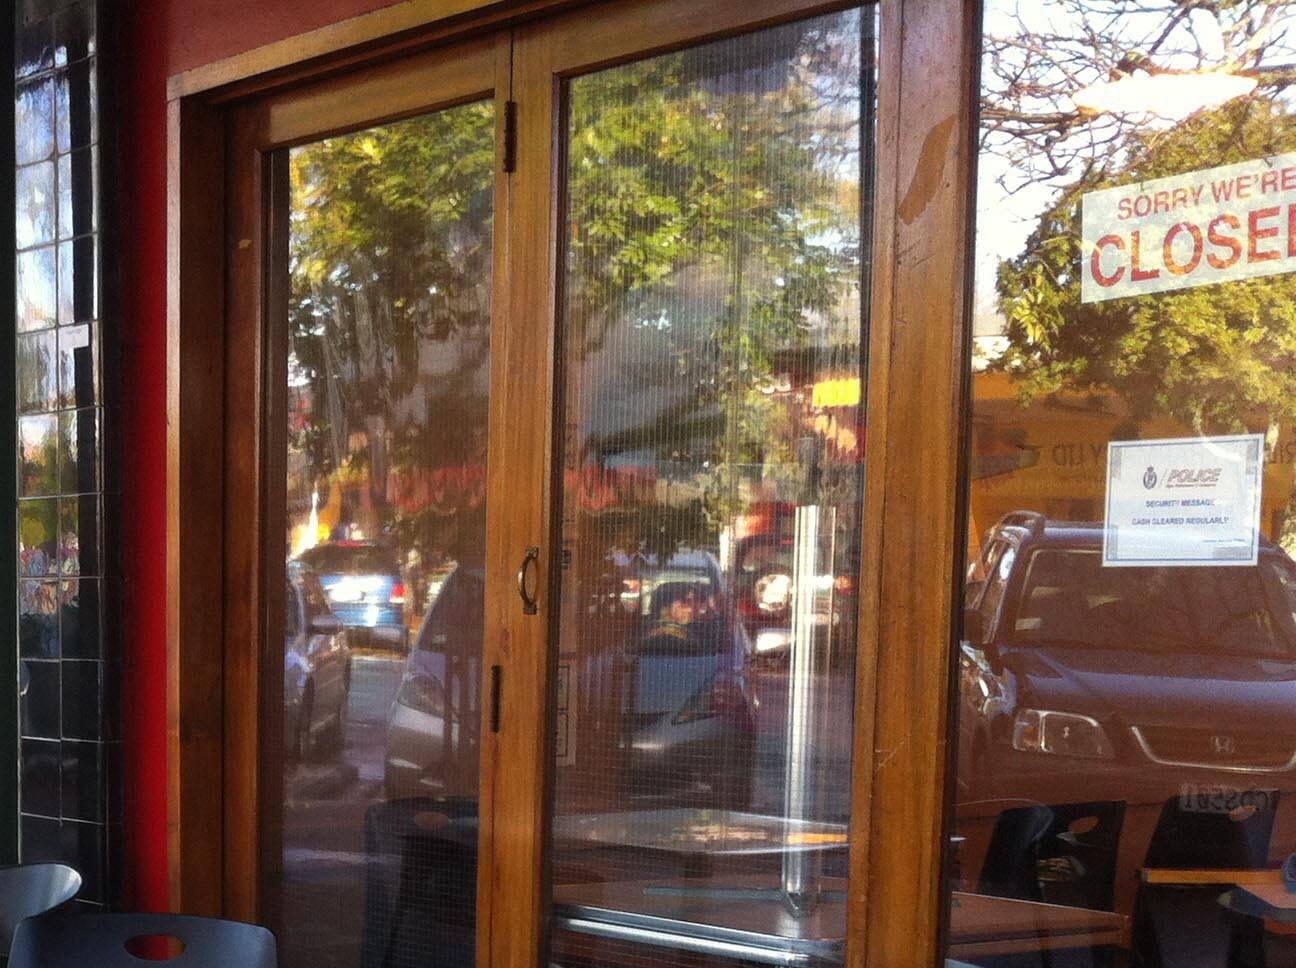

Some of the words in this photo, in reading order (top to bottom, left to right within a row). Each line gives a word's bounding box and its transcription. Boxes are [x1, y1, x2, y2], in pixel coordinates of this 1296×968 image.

[1116, 184, 1204, 220] SORRY
[1211, 166, 1296, 203] WE'RE
[1167, 467, 1223, 483] POLICE
[1145, 499, 1180, 509] SECURITY
[1131, 517, 1151, 526] CASH
[1151, 517, 1185, 526] CLEARED
[1185, 516, 1230, 525] REGULARLY
